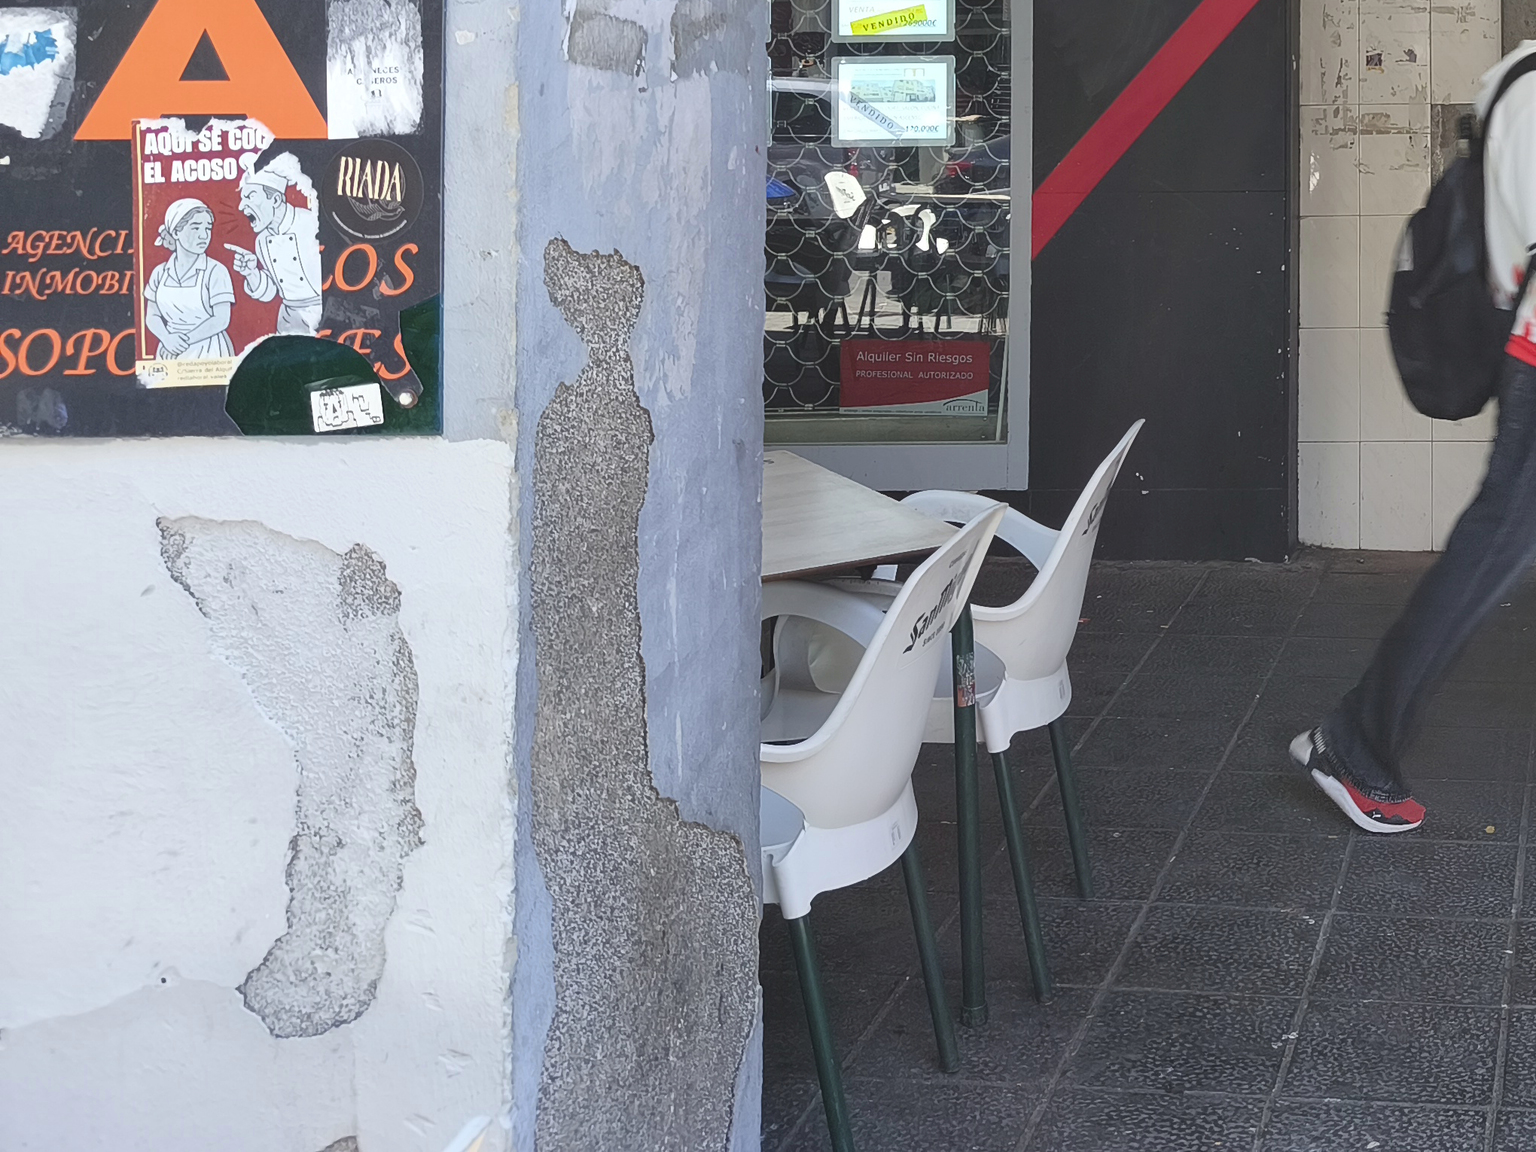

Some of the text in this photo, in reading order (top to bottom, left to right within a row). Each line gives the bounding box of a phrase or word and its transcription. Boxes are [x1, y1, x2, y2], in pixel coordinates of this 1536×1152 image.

[862, 12, 915, 32] VENDIDO
[198, 129, 223, 152] SE
[144, 157, 238, 184] EL ACOSO
[337, 156, 402, 202] RIADA
[1, 227, 135, 263] AGENCI
[1, 267, 135, 300] INMOBI
[856, 350, 973, 365] Alquiler Sin Riesgos
[855, 370, 974, 380] PROFESIONAL AUTORIZADO
